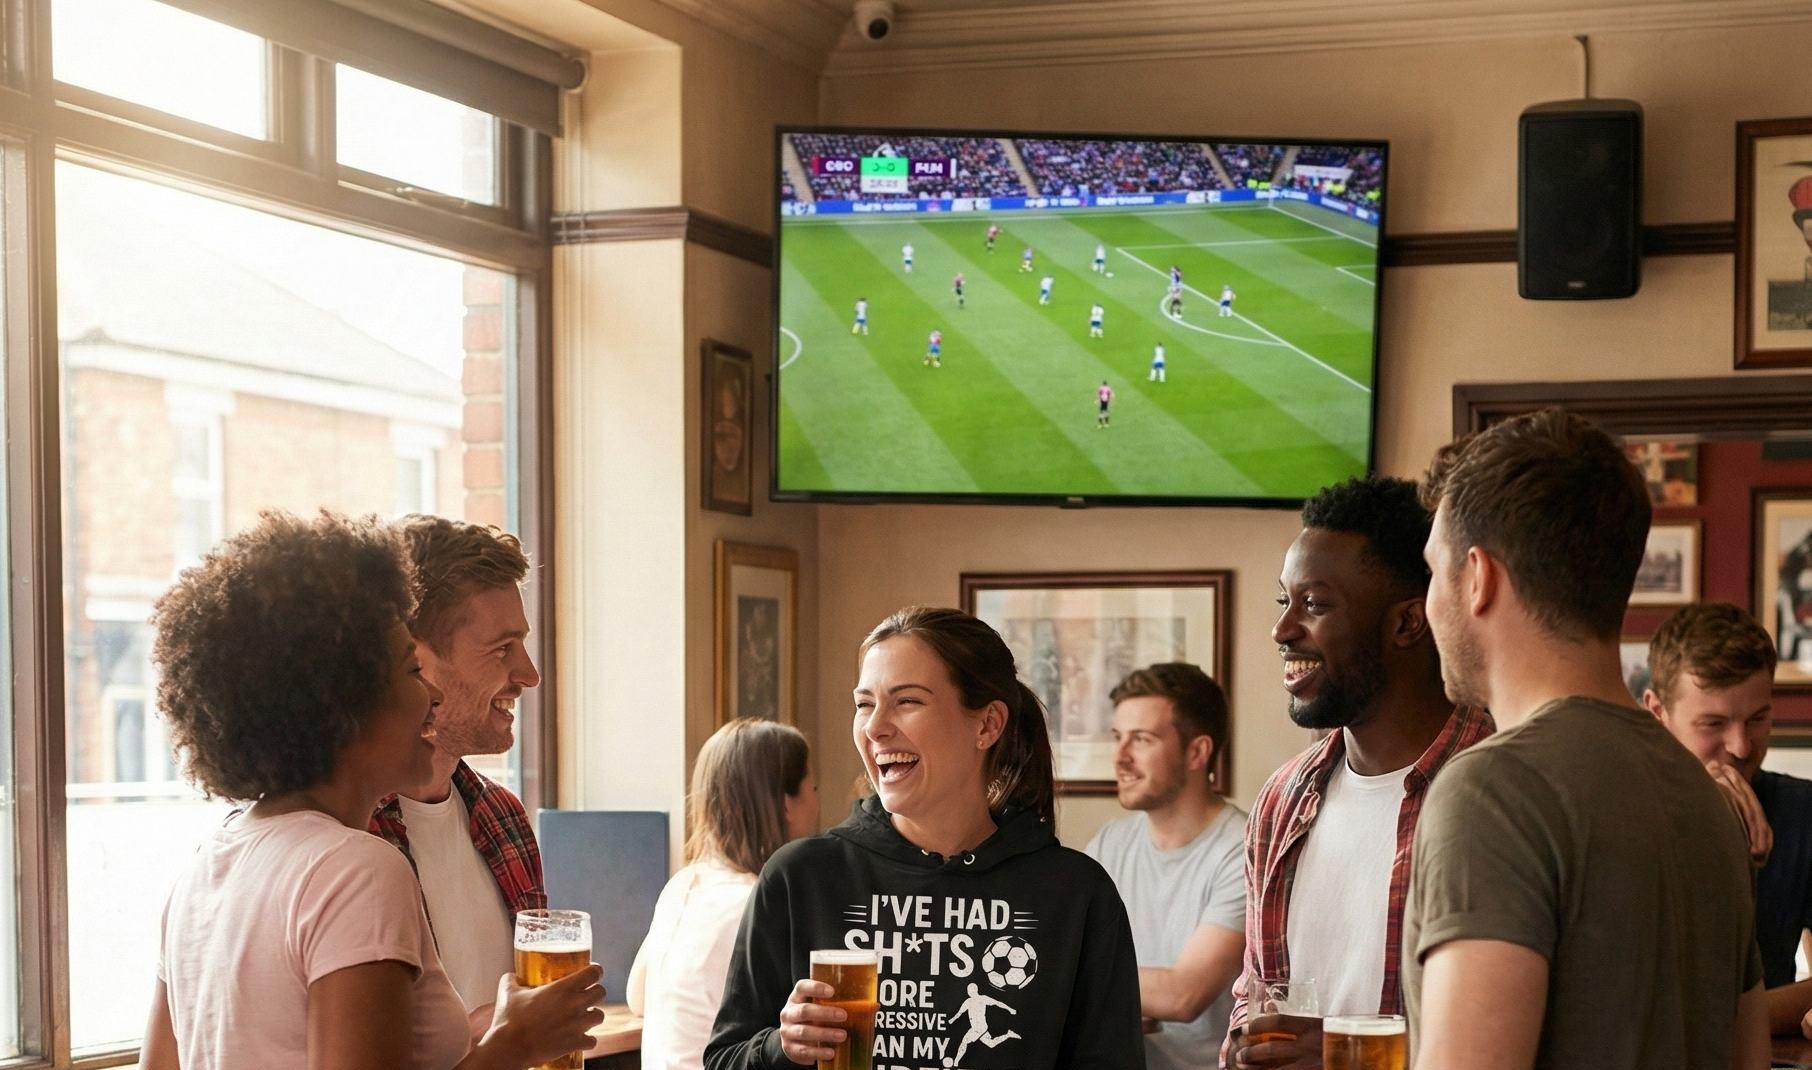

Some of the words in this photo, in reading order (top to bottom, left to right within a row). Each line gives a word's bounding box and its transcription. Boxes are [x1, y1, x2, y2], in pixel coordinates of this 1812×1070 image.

[871, 894, 932, 928] I'VE
[944, 896, 1010, 930] HAD
[879, 979, 935, 1009] ORE
[875, 1010, 947, 1031] RESSIVE
[872, 1034, 905, 1059] AN
[913, 1036, 951, 1060] MY
